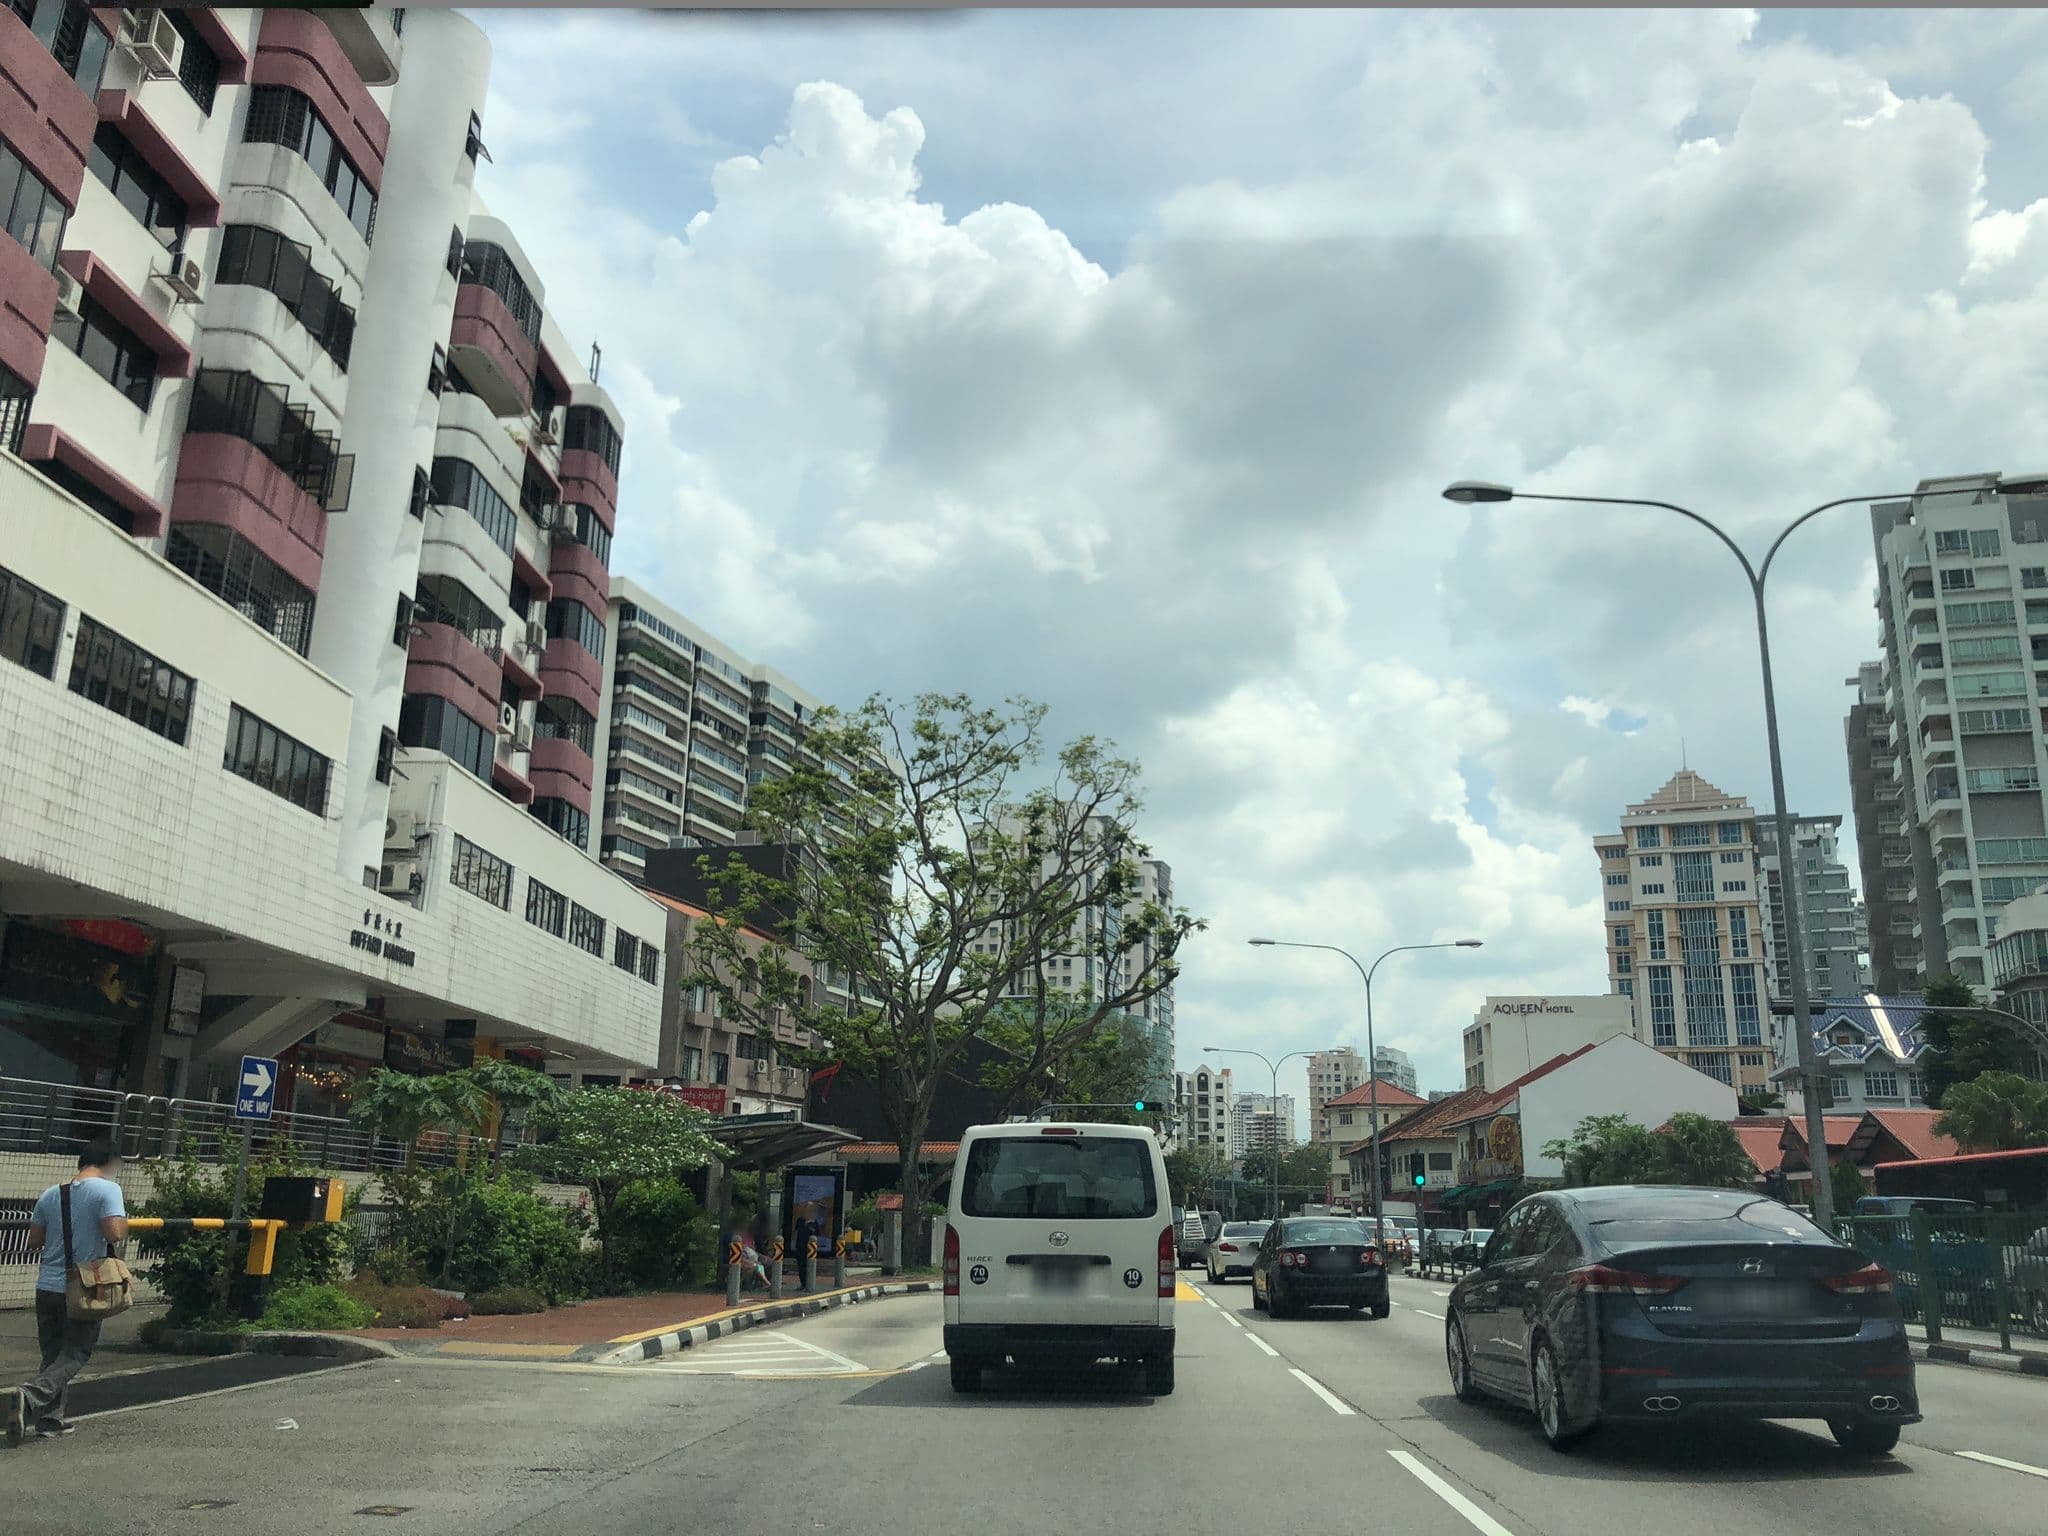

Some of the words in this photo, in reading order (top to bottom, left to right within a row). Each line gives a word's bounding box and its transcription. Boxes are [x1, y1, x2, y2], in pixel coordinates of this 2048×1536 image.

[1493, 1003, 1543, 1015] AQUEEN
[240, 1099, 255, 1112] ONE
[256, 1101, 270, 1114] WAY
[972, 1267, 985, 1276] 70
[1126, 1271, 1139, 1280] 10
